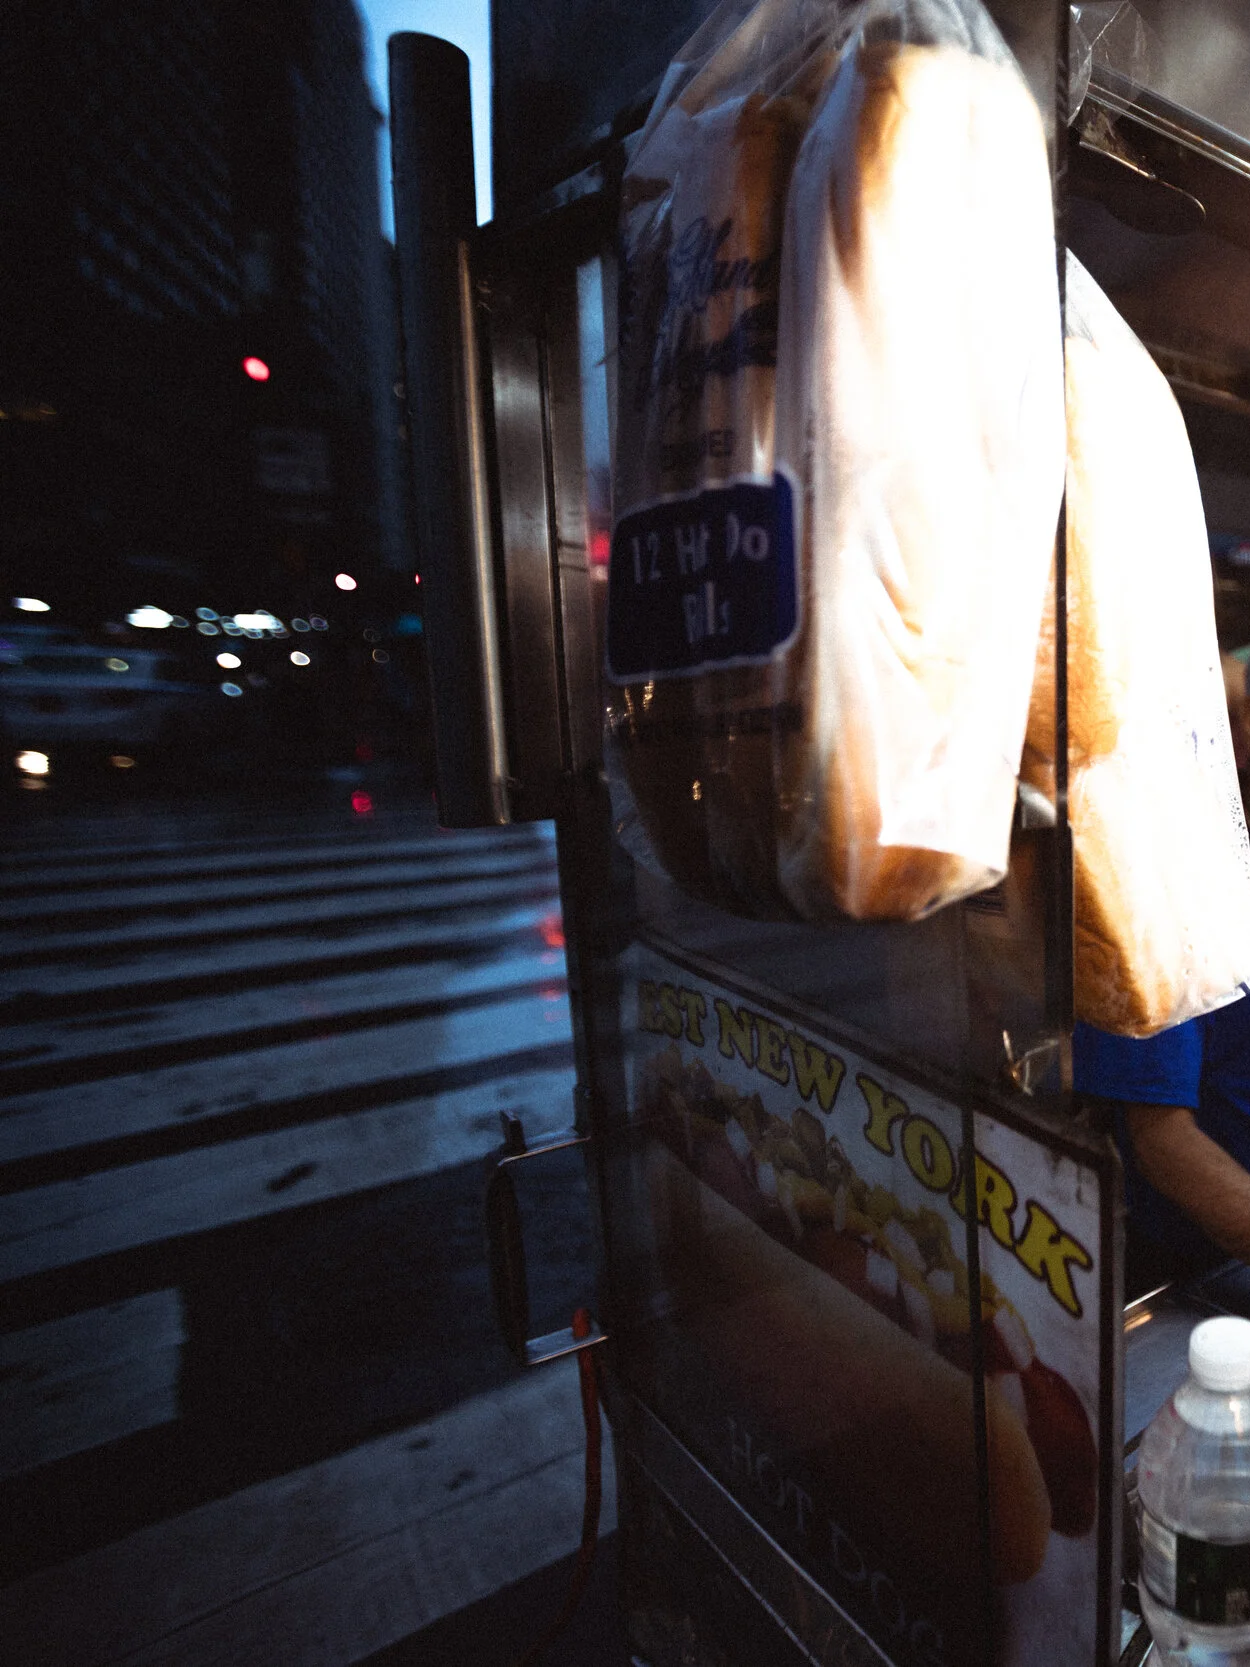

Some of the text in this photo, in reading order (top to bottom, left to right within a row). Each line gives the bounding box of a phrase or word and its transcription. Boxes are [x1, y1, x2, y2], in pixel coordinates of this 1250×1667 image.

[631, 530, 662, 585] 12
[713, 997, 847, 1115] NEW
[855, 1071, 1094, 1320] YORK
[726, 1415, 816, 1535] HOT
